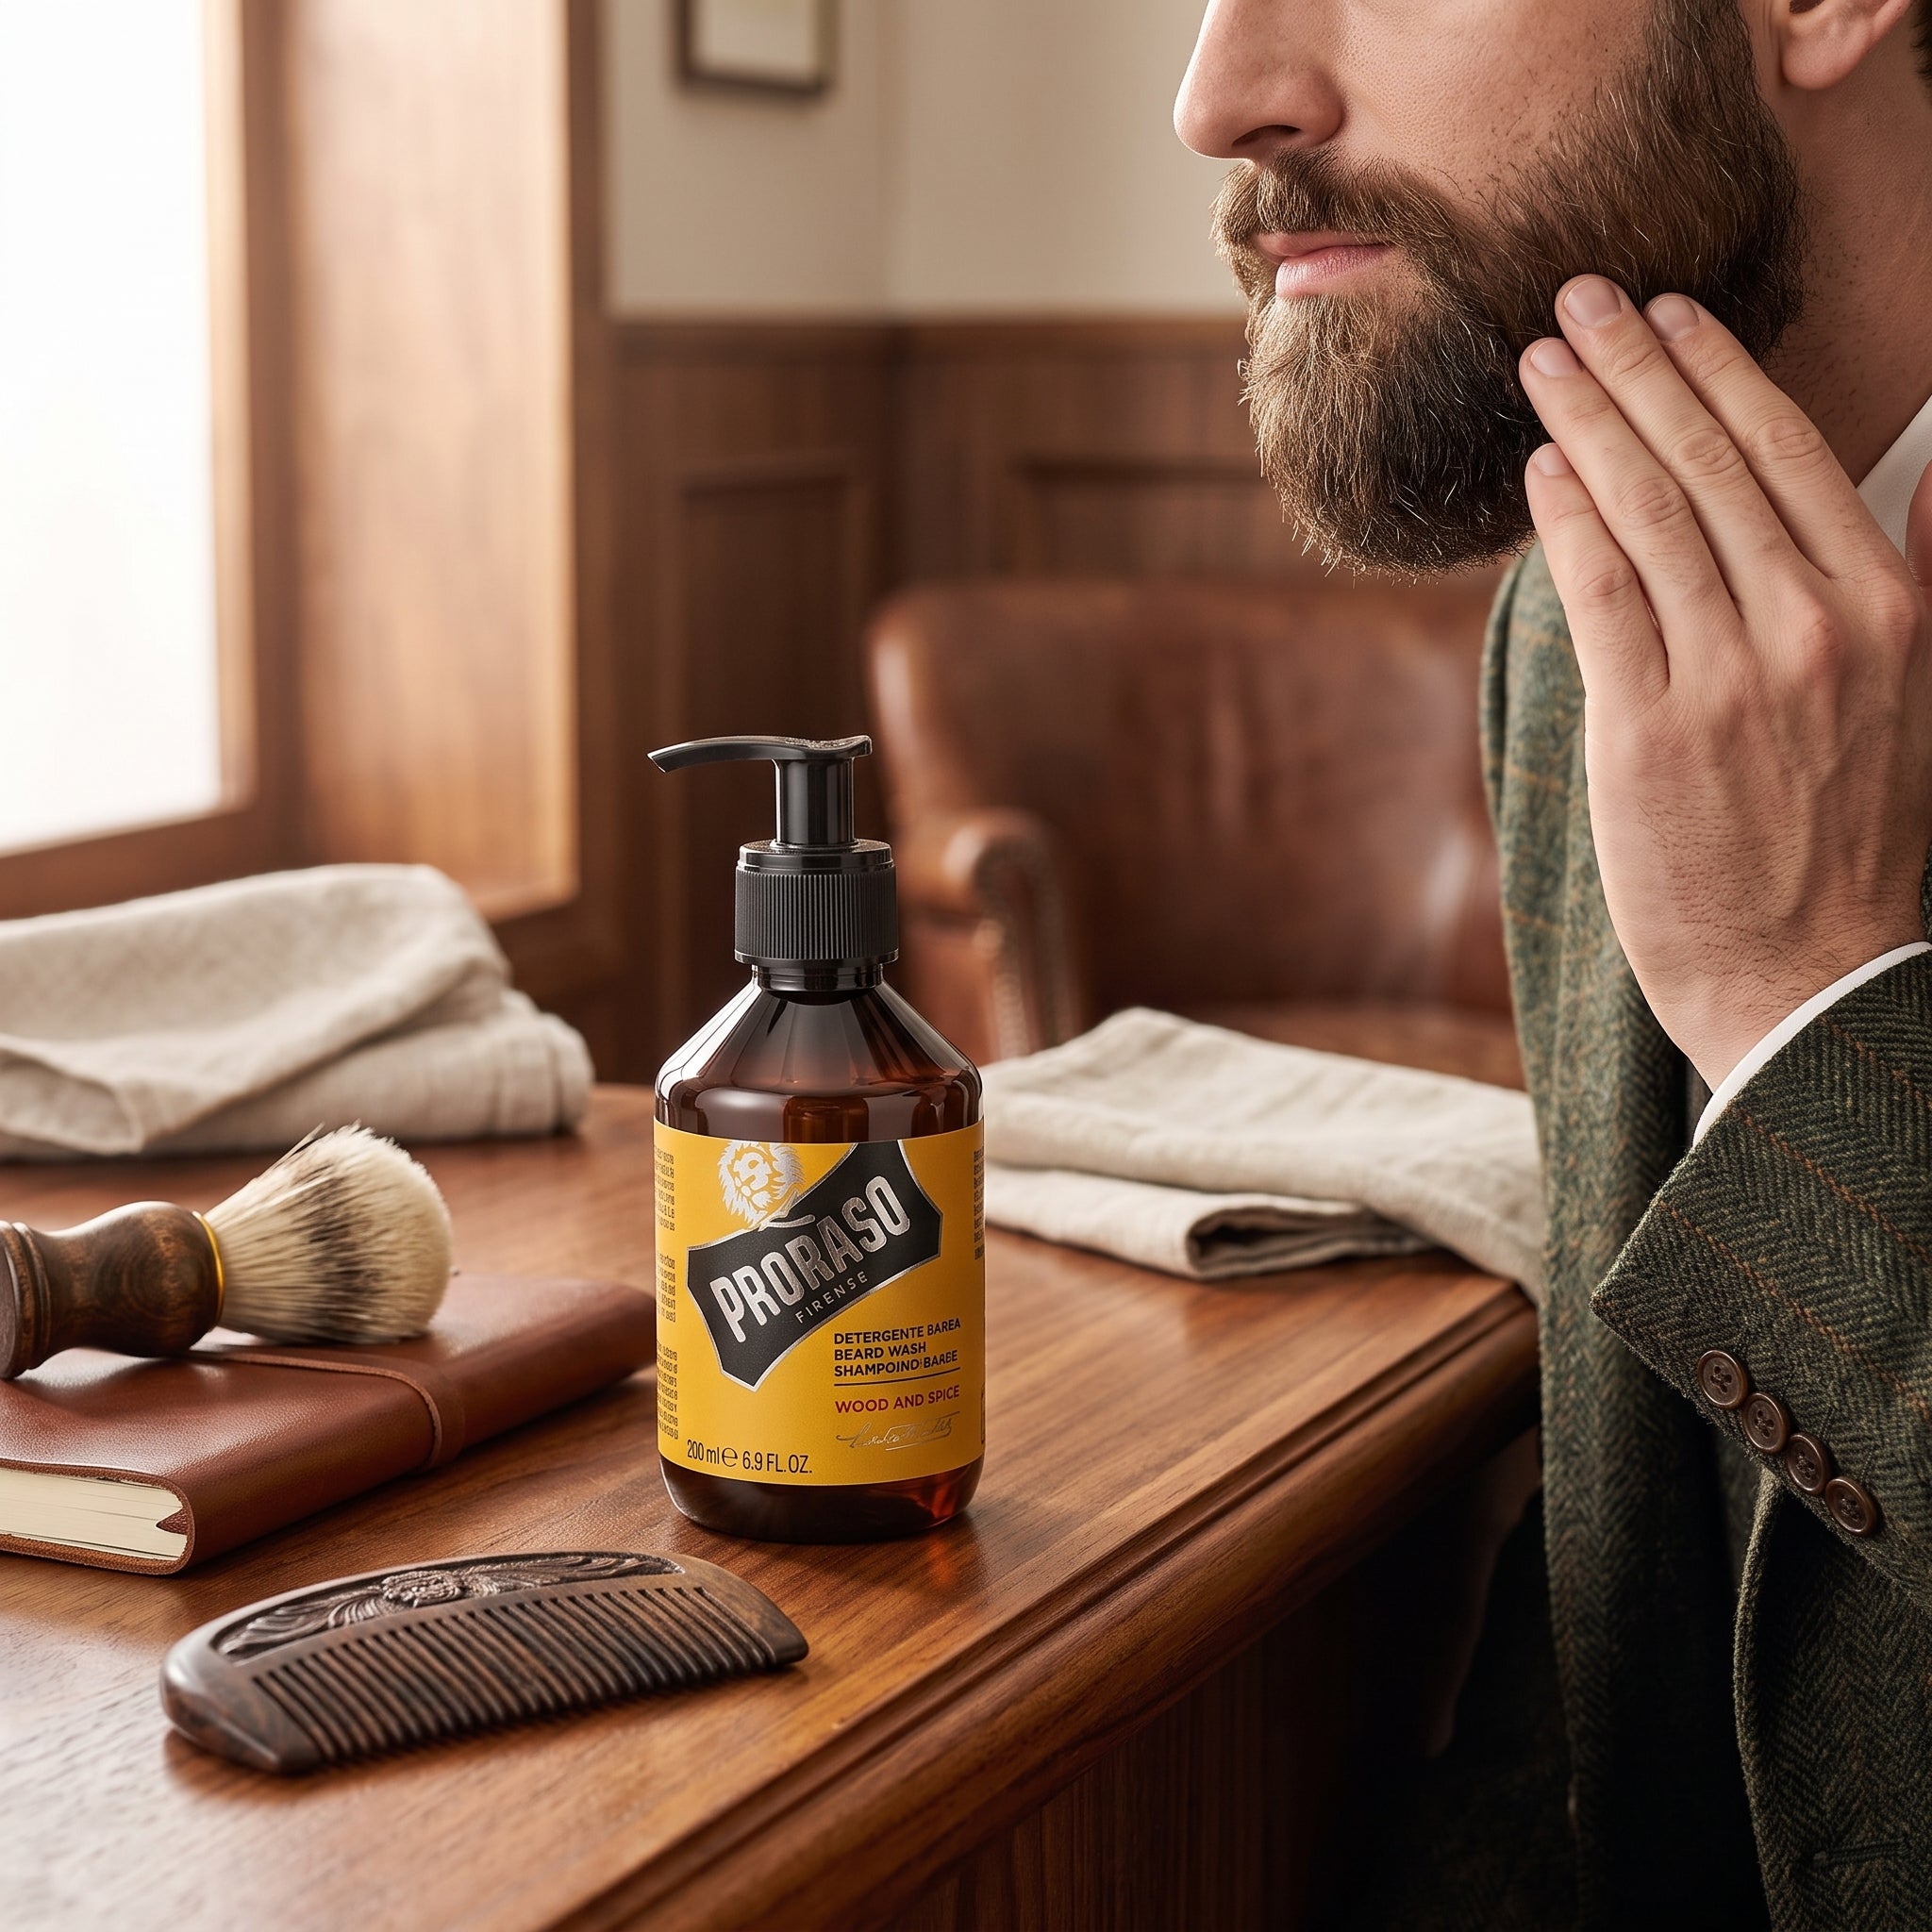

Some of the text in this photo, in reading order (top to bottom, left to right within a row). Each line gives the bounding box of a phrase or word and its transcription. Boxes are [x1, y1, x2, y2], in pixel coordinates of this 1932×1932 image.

[709, 1175, 910, 1343] PRORASO
[795, 1271, 868, 1324] FIRENSE
[834, 1318, 961, 1344] DETERGENTE BAREA
[834, 1341, 926, 1361] BEARD WASH
[835, 1385, 960, 1413] WOOD AND SPICE
[687, 1439, 705, 1461] 200
[706, 1446, 720, 1465] ml
[742, 1451, 763, 1472] 6.9
